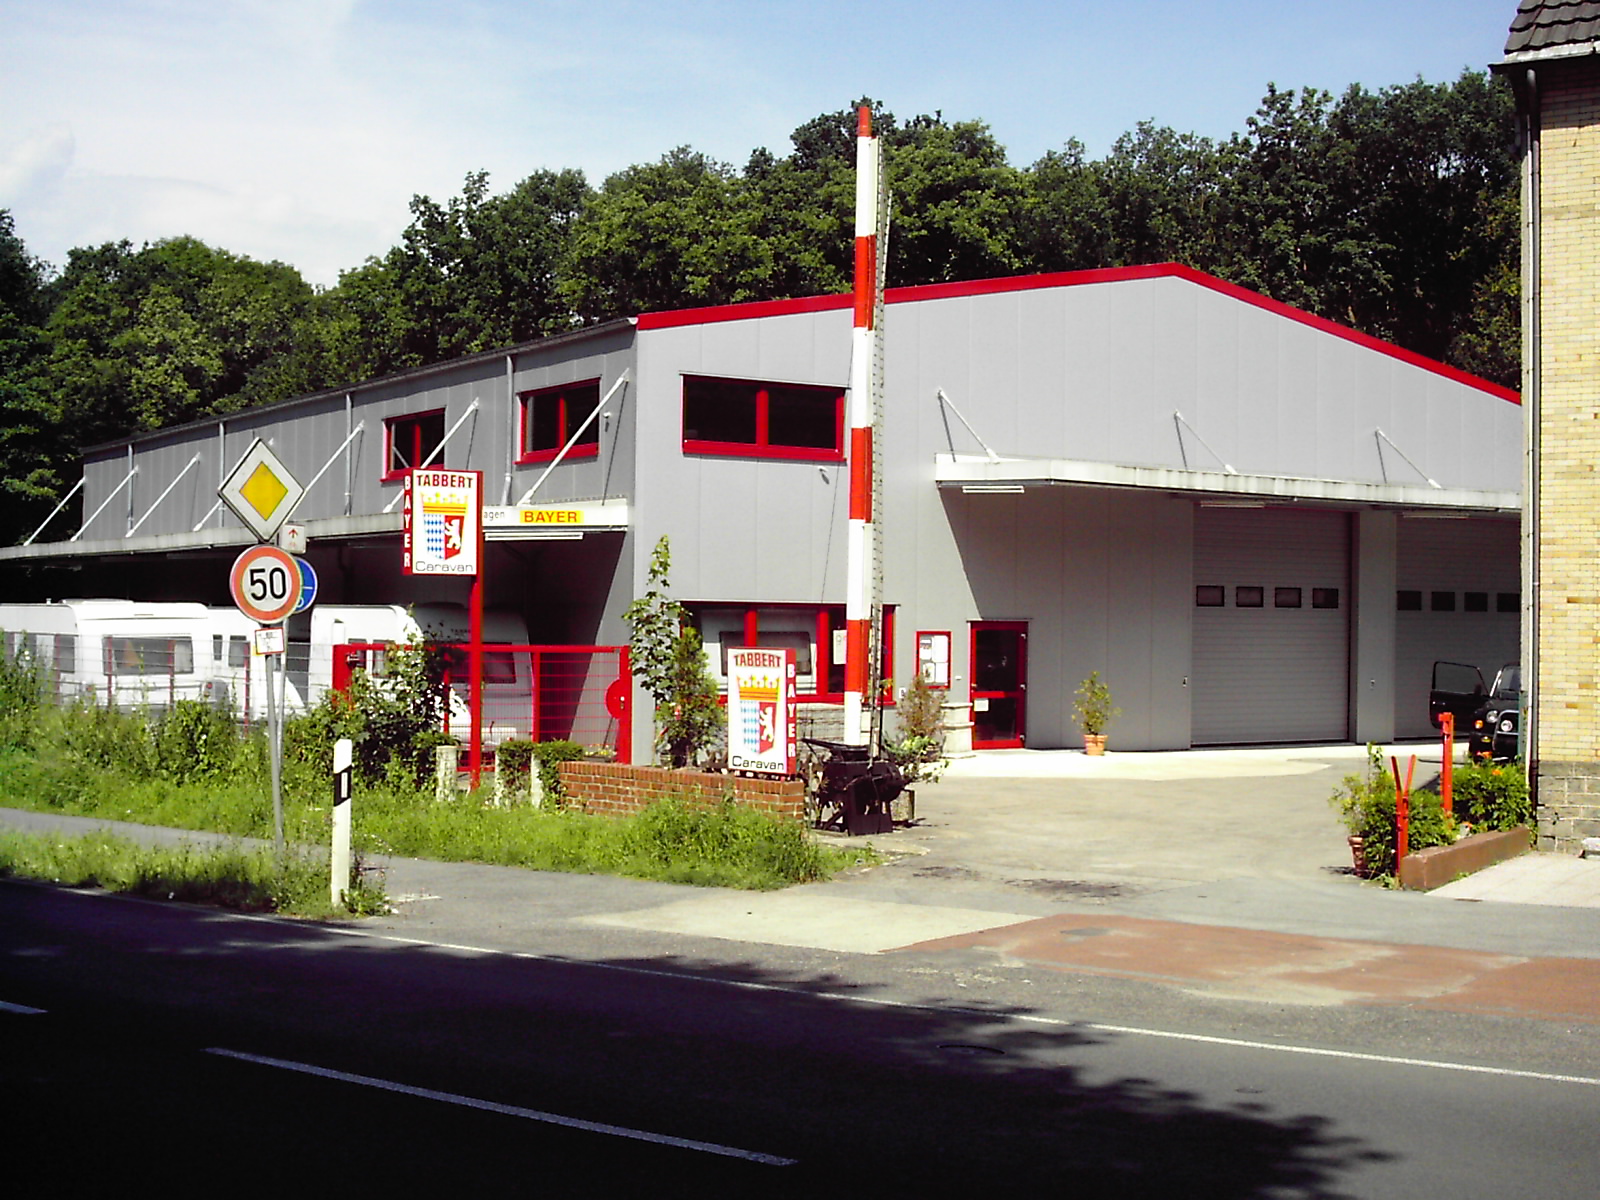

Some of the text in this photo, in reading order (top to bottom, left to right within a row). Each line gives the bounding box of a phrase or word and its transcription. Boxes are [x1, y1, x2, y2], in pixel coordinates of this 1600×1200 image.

[416, 474, 473, 488] TABBERT
[404, 475, 412, 567] BAYER
[483, 510, 577, 523] agen BAYER
[415, 561, 473, 572] Caravan
[250, 567, 287, 601] 50
[734, 652, 782, 667] TABBERT
[787, 664, 796, 757] BAYER
[732, 756, 784, 770] Caravan
